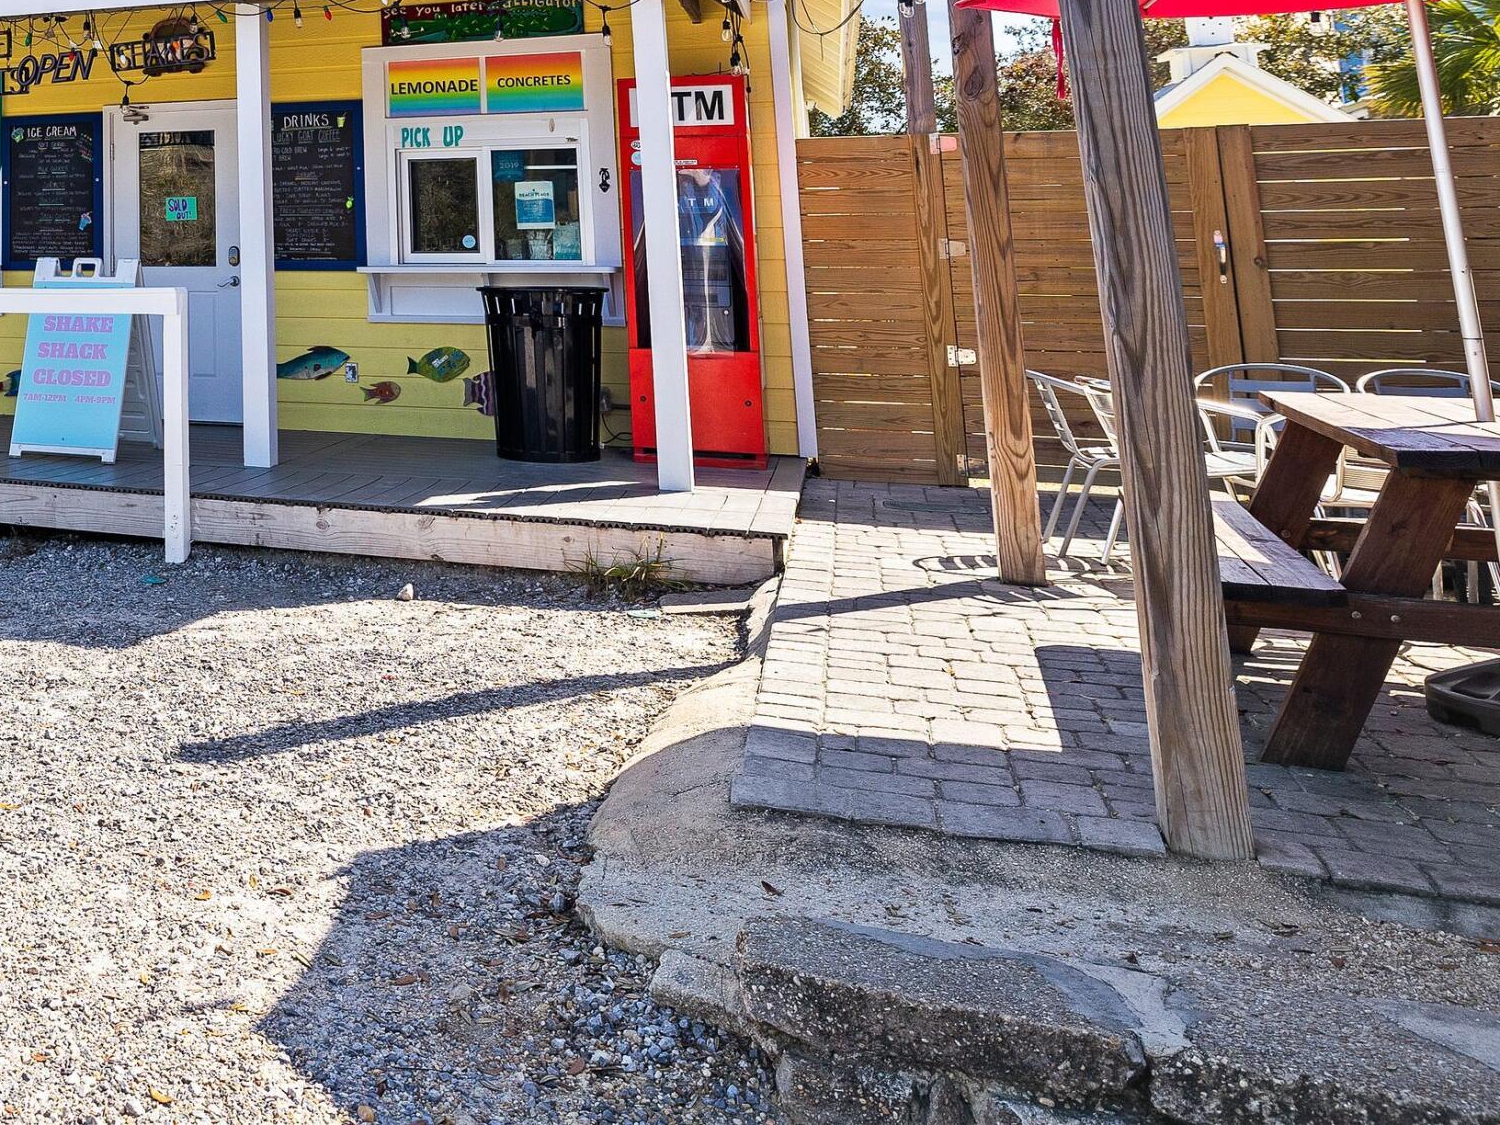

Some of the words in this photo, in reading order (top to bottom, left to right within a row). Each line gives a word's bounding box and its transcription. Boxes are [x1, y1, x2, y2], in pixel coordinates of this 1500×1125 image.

[384, 6, 407, 19] see
[416, 6, 440, 17] you
[115, 33, 210, 70] SHAKES
[17, 50, 96, 86] OPEN
[391, 79, 478, 95] LEMONADE
[497, 75, 571, 89] CONCRETES
[670, 89, 725, 122] TM
[283, 113, 329, 128] DRINKS
[27, 127, 44, 138] ICE
[46, 126, 77, 137] CREAM
[401, 127, 431, 148] PICK
[443, 125, 464, 147] UP
[500, 161, 520, 169] 2019
[167, 199, 187, 212] SOLD
[43, 315, 114, 333] SHAKE
[37, 342, 108, 360] SHACK
[32, 369, 111, 387] CLOSED
